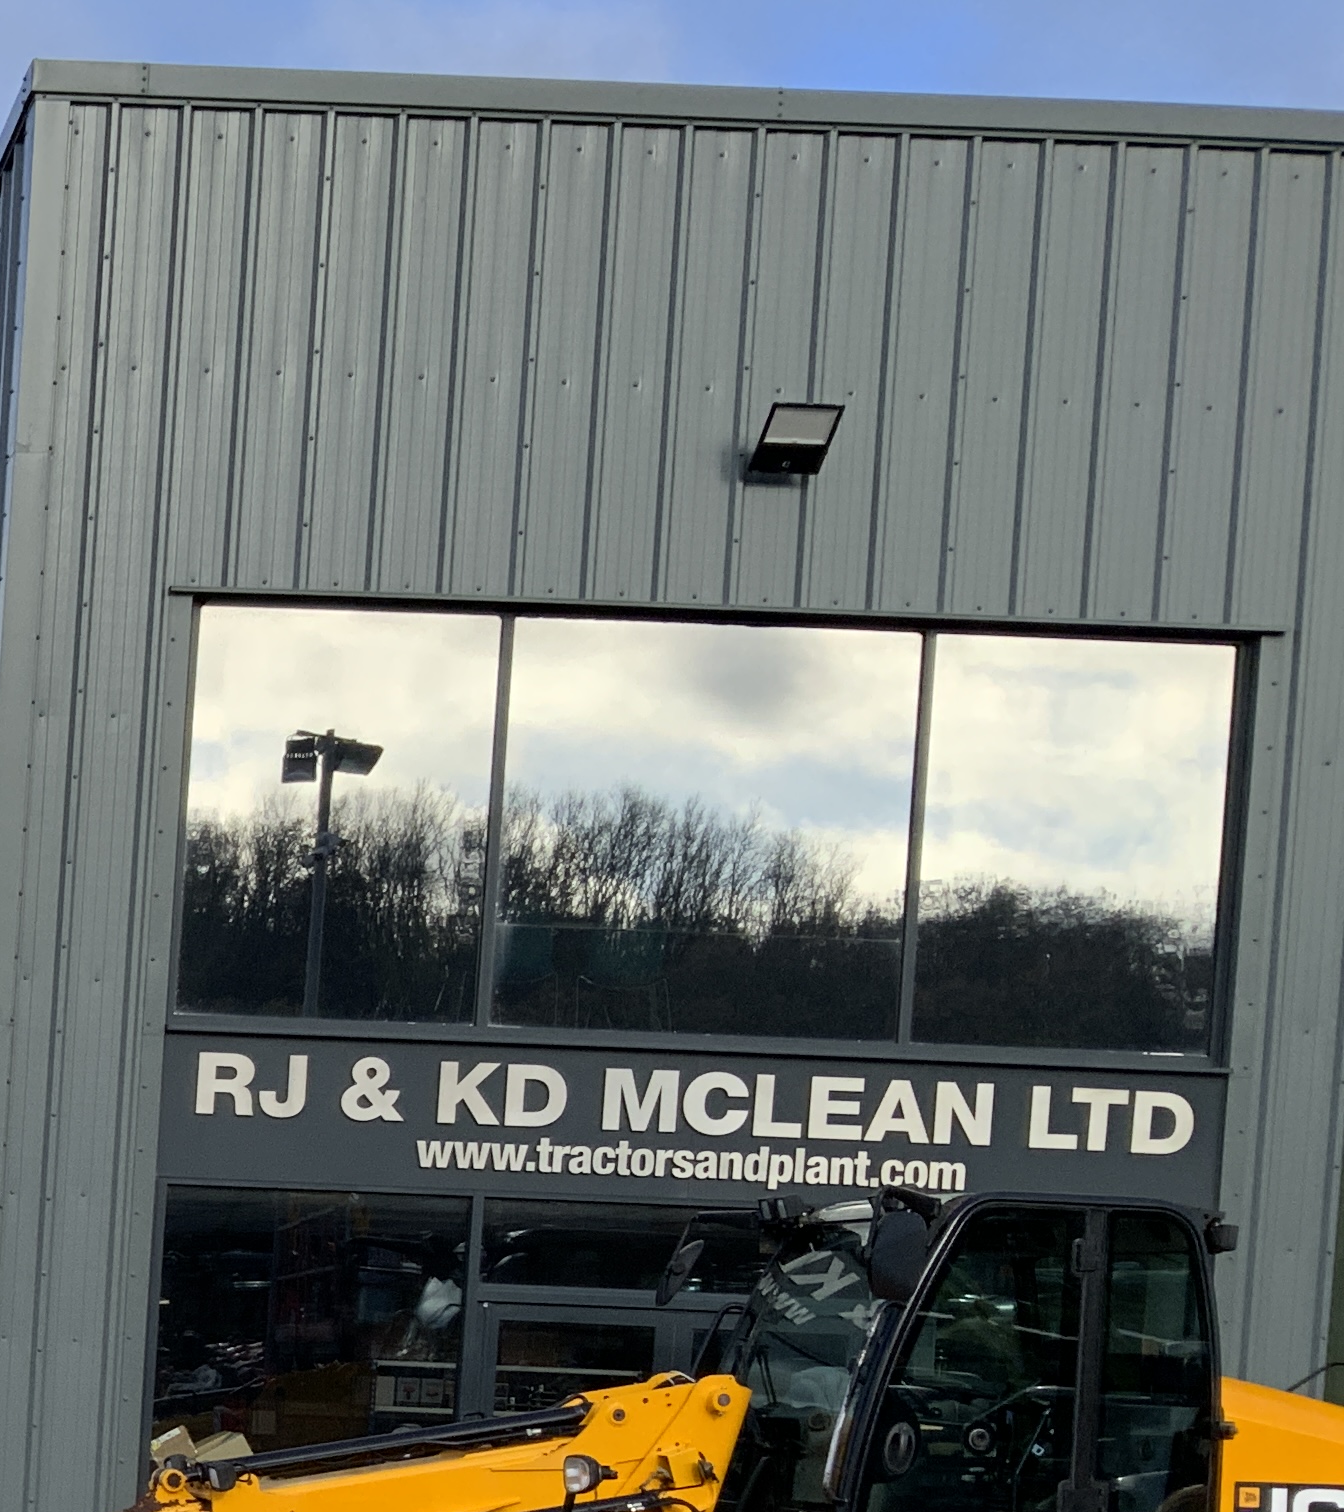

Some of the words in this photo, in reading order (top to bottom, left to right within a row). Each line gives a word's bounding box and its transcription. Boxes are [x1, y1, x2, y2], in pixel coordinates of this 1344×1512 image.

[194, 1051, 308, 1119] RJ
[340, 1056, 404, 1122] &
[436, 1060, 568, 1127] KD
[601, 1067, 996, 1147] MCLEAN
[1028, 1084, 1195, 1155] LTD
[416, 1136, 967, 1191] www.tractorsandplant.com
